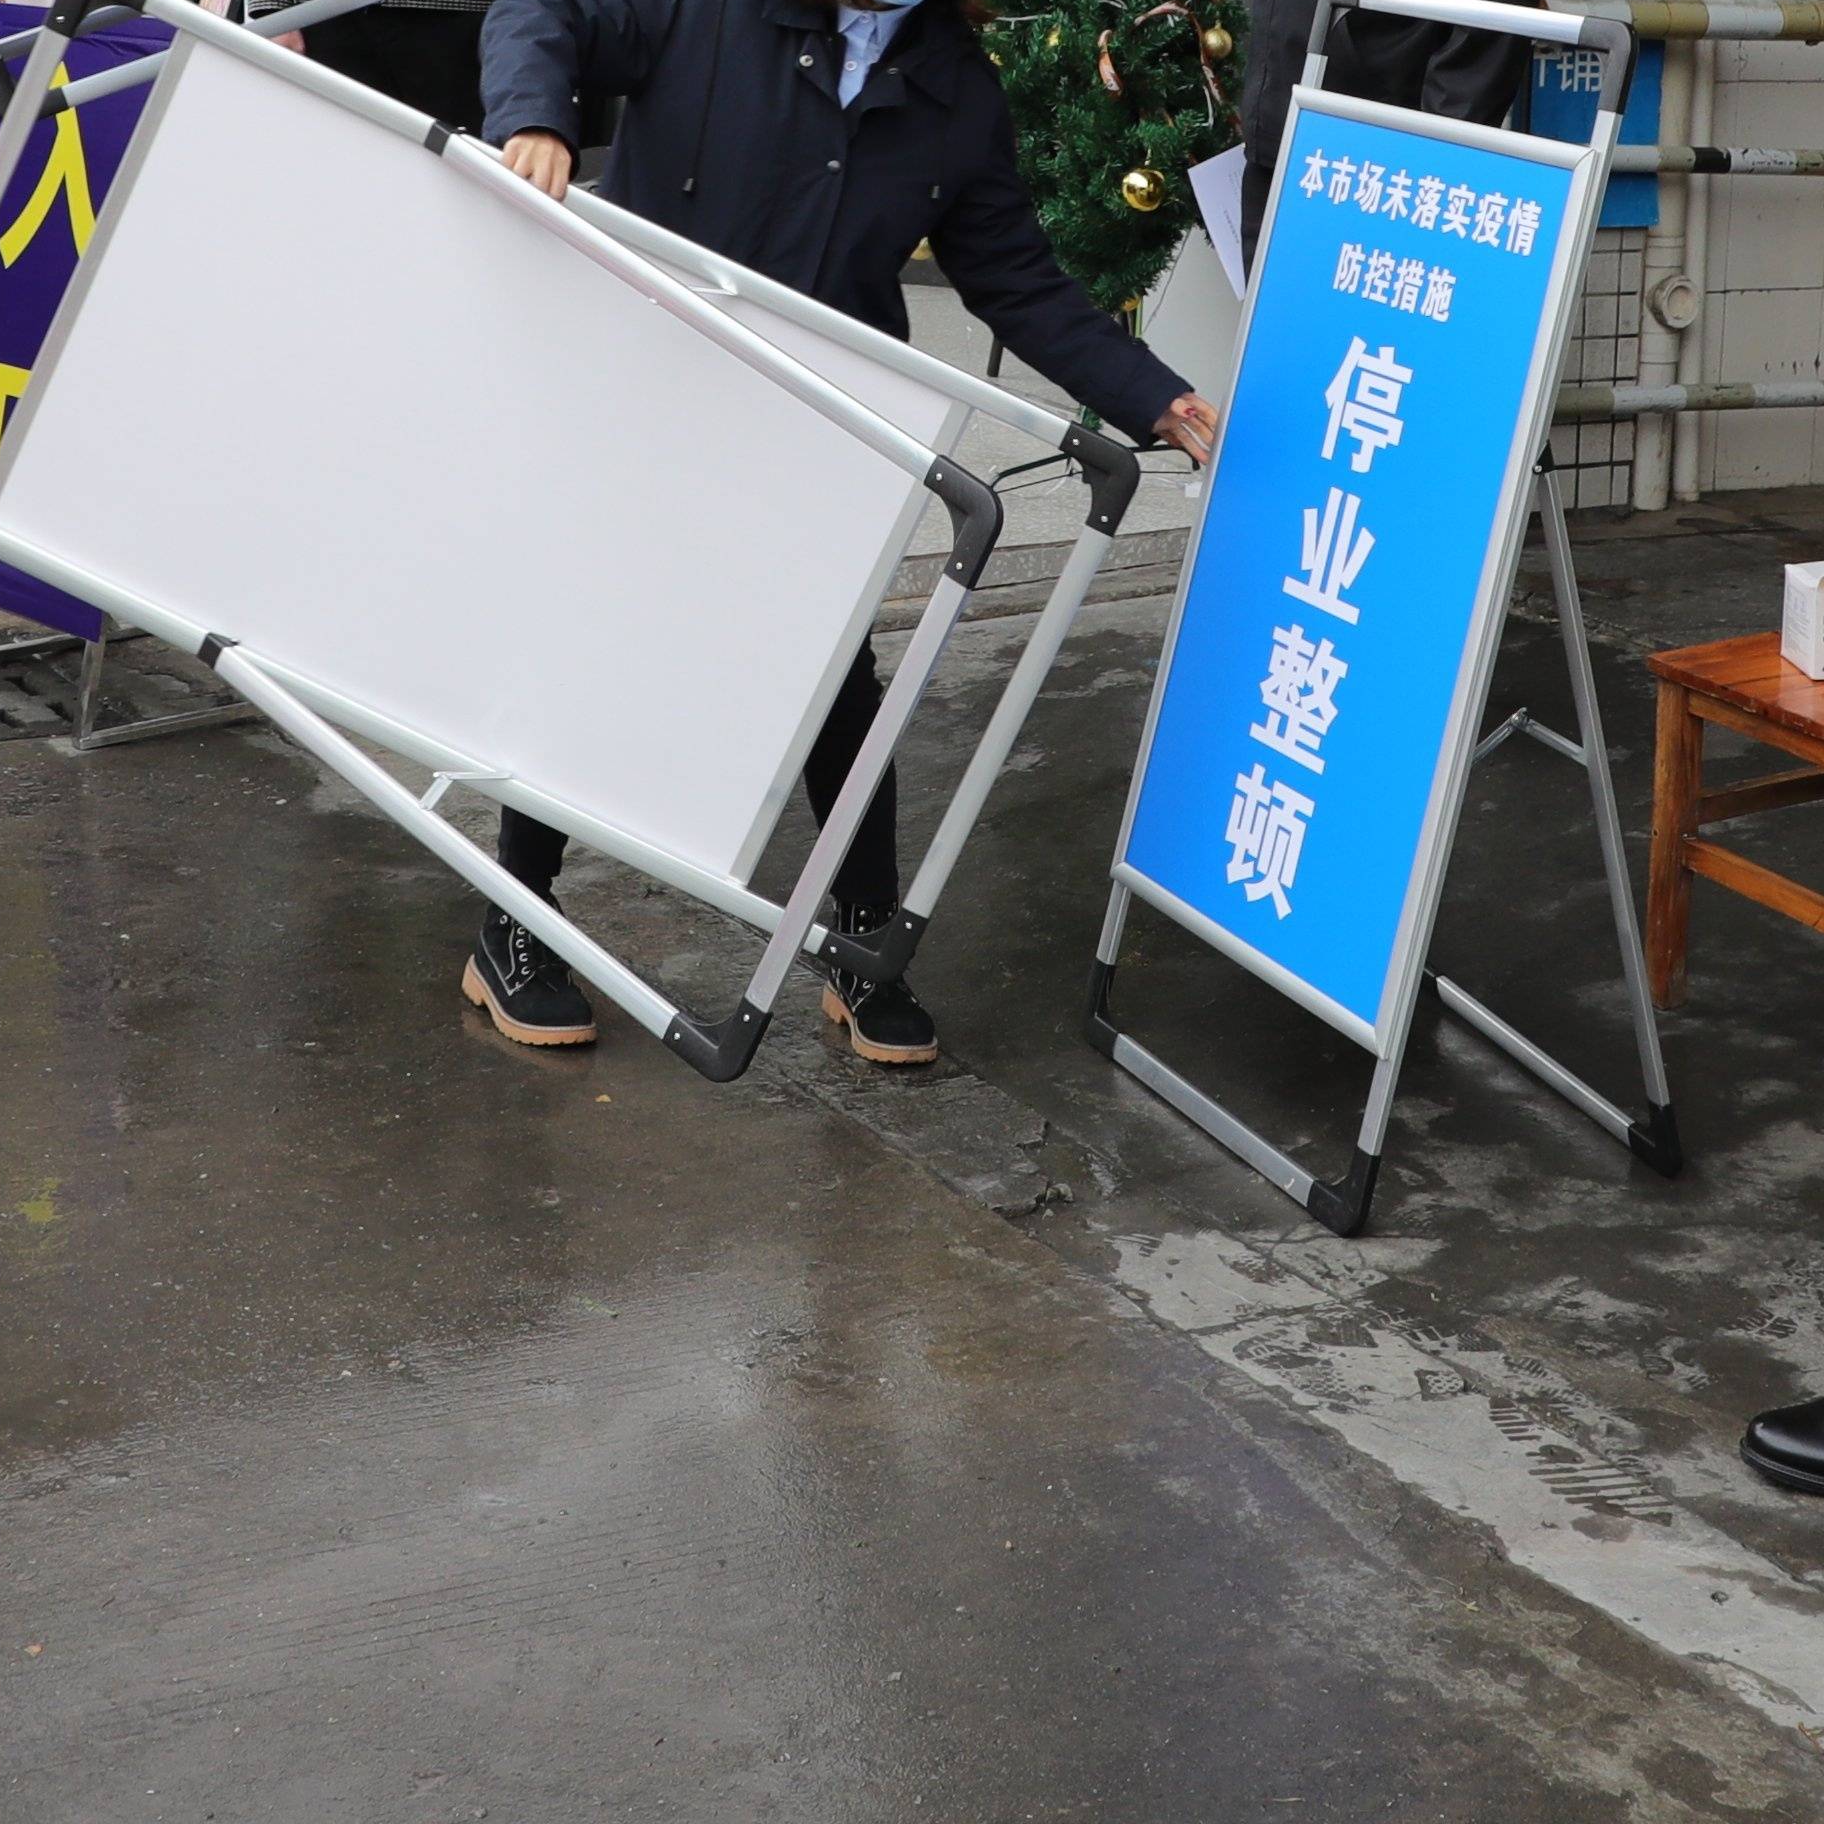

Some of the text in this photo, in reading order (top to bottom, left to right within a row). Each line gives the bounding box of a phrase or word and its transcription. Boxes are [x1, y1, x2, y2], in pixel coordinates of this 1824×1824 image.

[1299, 146, 1543, 260] 本市场未落实疫情
[1332, 240, 1458, 325] 防控措施
[1225, 333, 1416, 922] 停业整顿
